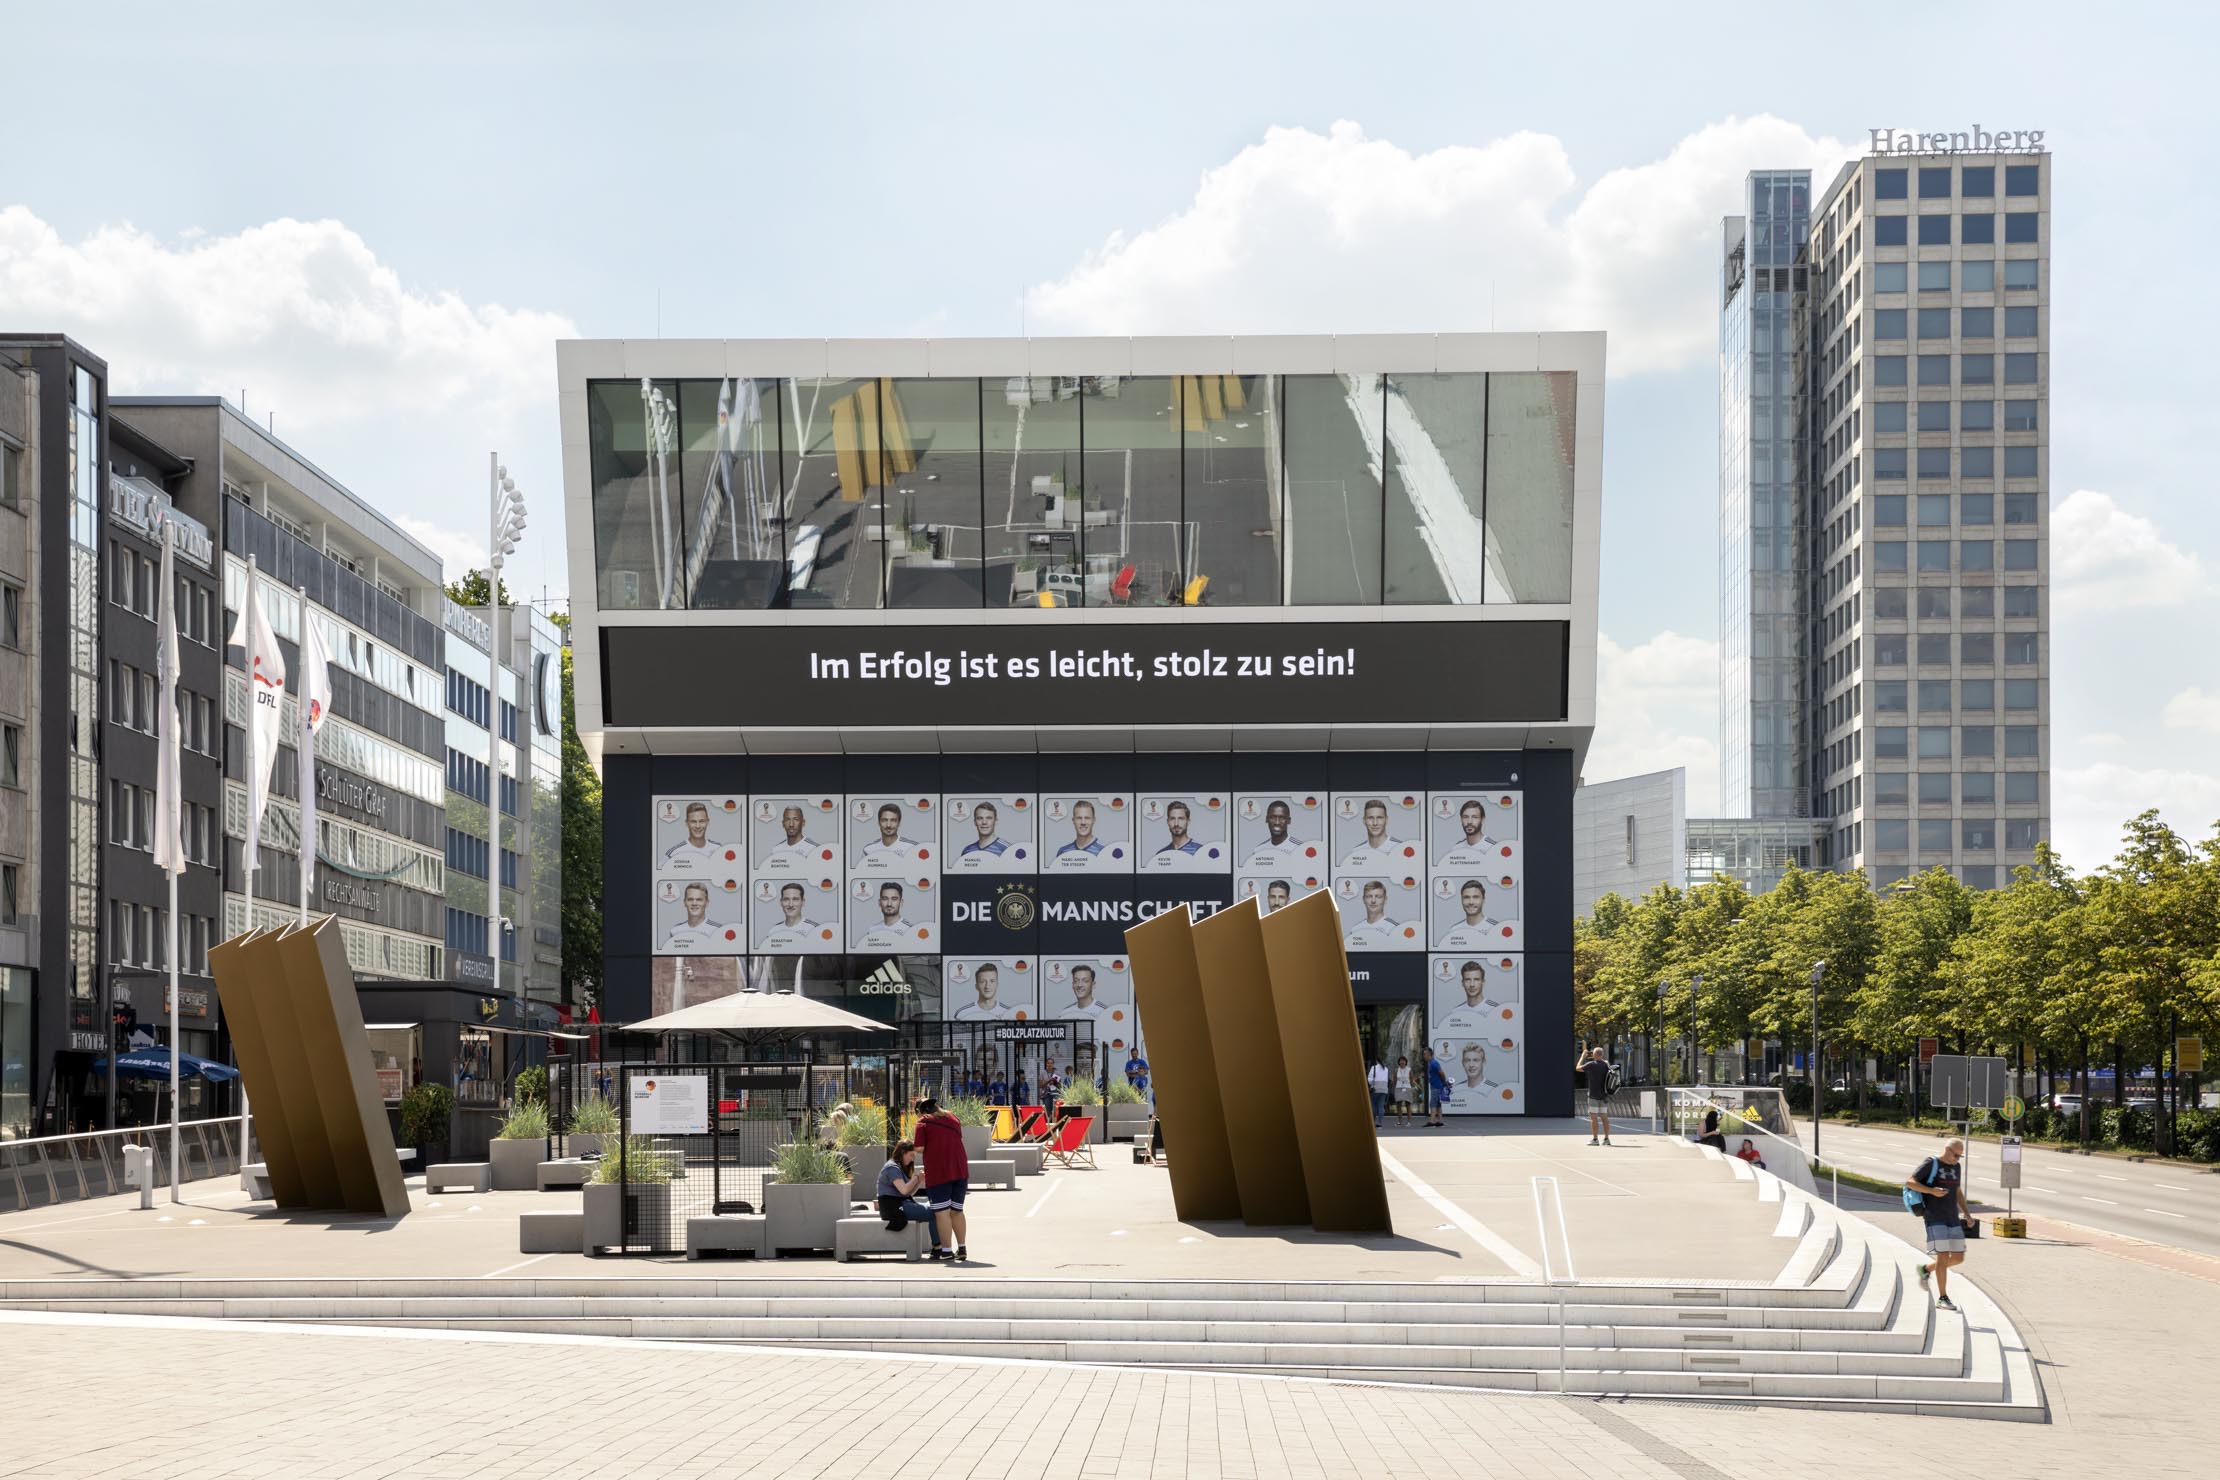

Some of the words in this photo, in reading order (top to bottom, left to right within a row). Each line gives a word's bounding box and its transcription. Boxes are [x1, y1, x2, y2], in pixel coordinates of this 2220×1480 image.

[1869, 124, 2046, 155] Harenberg
[811, 652, 850, 679] Im
[860, 651, 951, 686] Erfolg
[960, 650, 998, 679] ist
[1007, 657, 1040, 678] es
[1050, 649, 1143, 682] leicht,
[1153, 649, 1228, 677] stolz
[1237, 656, 1272, 676] zu
[1282, 648, 1354, 676] sein!
[257, 691, 277, 709] DFL
[365, 785, 387, 819] GRAF
[952, 901, 992, 921] DIE
[1042, 901, 1222, 921] MANNSCHFT
[860, 981, 912, 994] adidas
[996, 1027, 1065, 1039] #BOLZPLATZKULTUR
